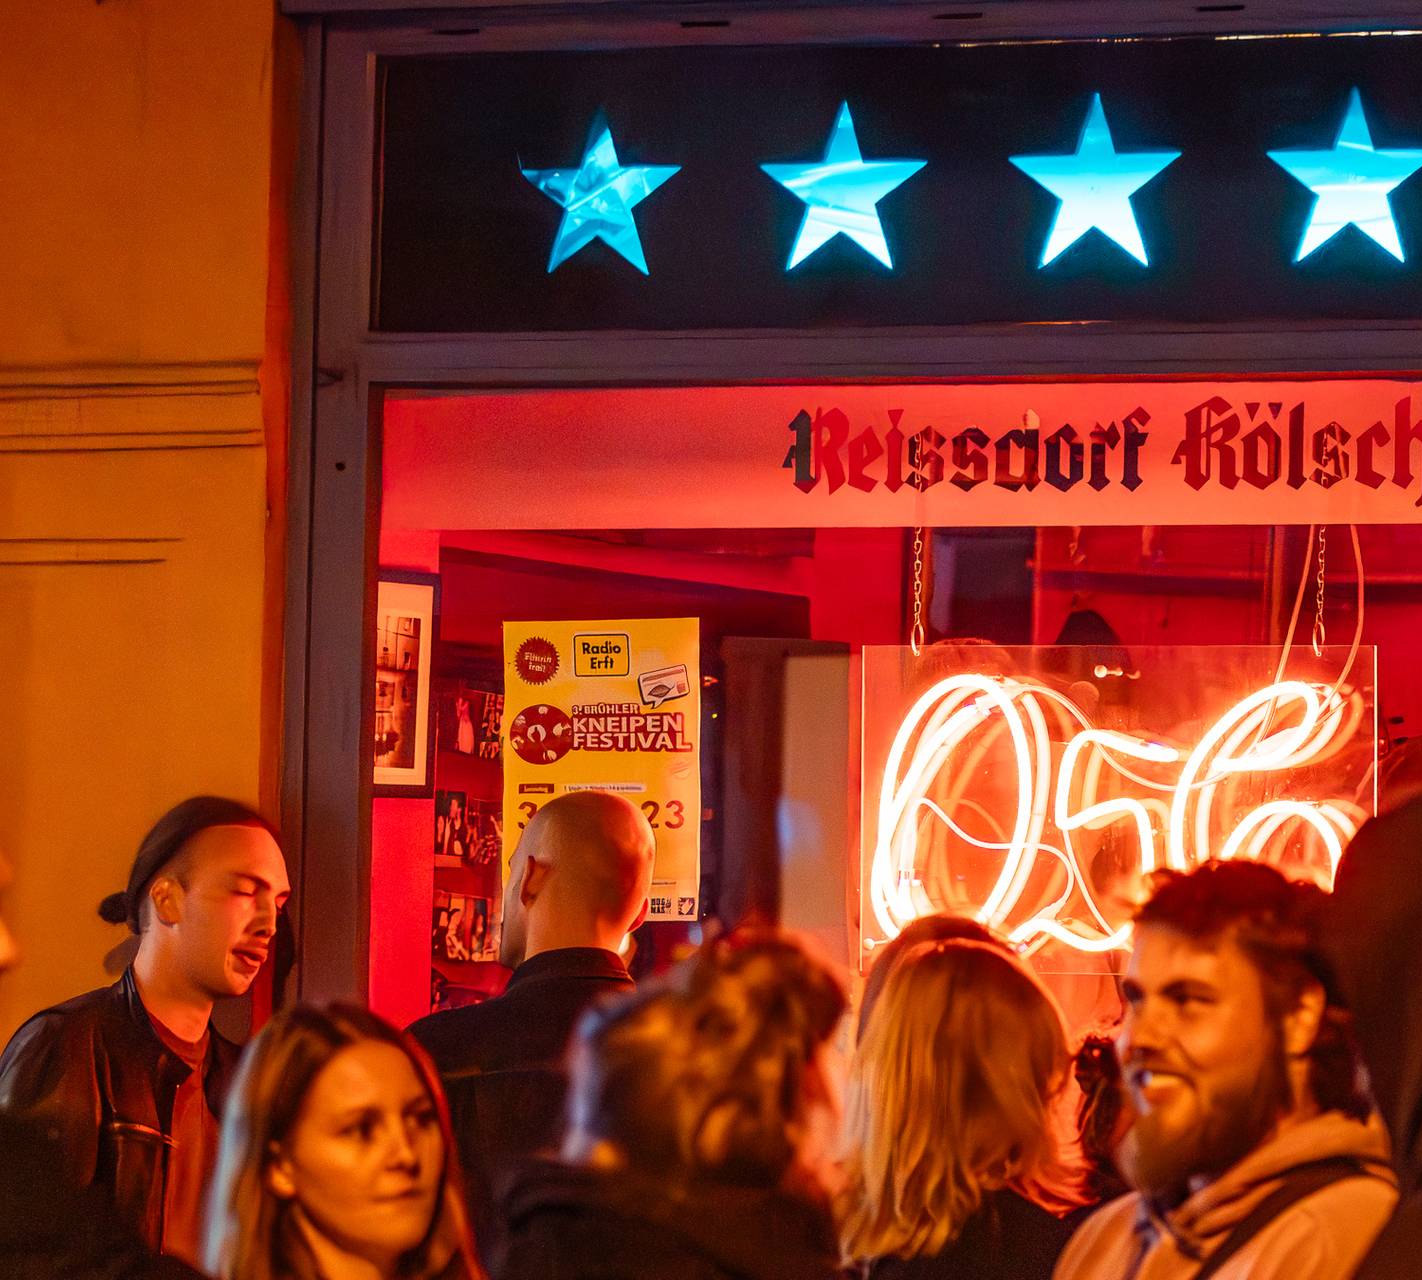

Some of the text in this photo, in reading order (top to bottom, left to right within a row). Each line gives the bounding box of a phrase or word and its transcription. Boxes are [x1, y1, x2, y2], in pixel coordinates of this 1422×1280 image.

[782, 406, 1151, 496] Reissdorf
[582, 641, 621, 654] Radio
[590, 655, 614, 669] Erft
[573, 713, 682, 733] KNEIPEN
[573, 732, 691, 749] FESTIVAL
